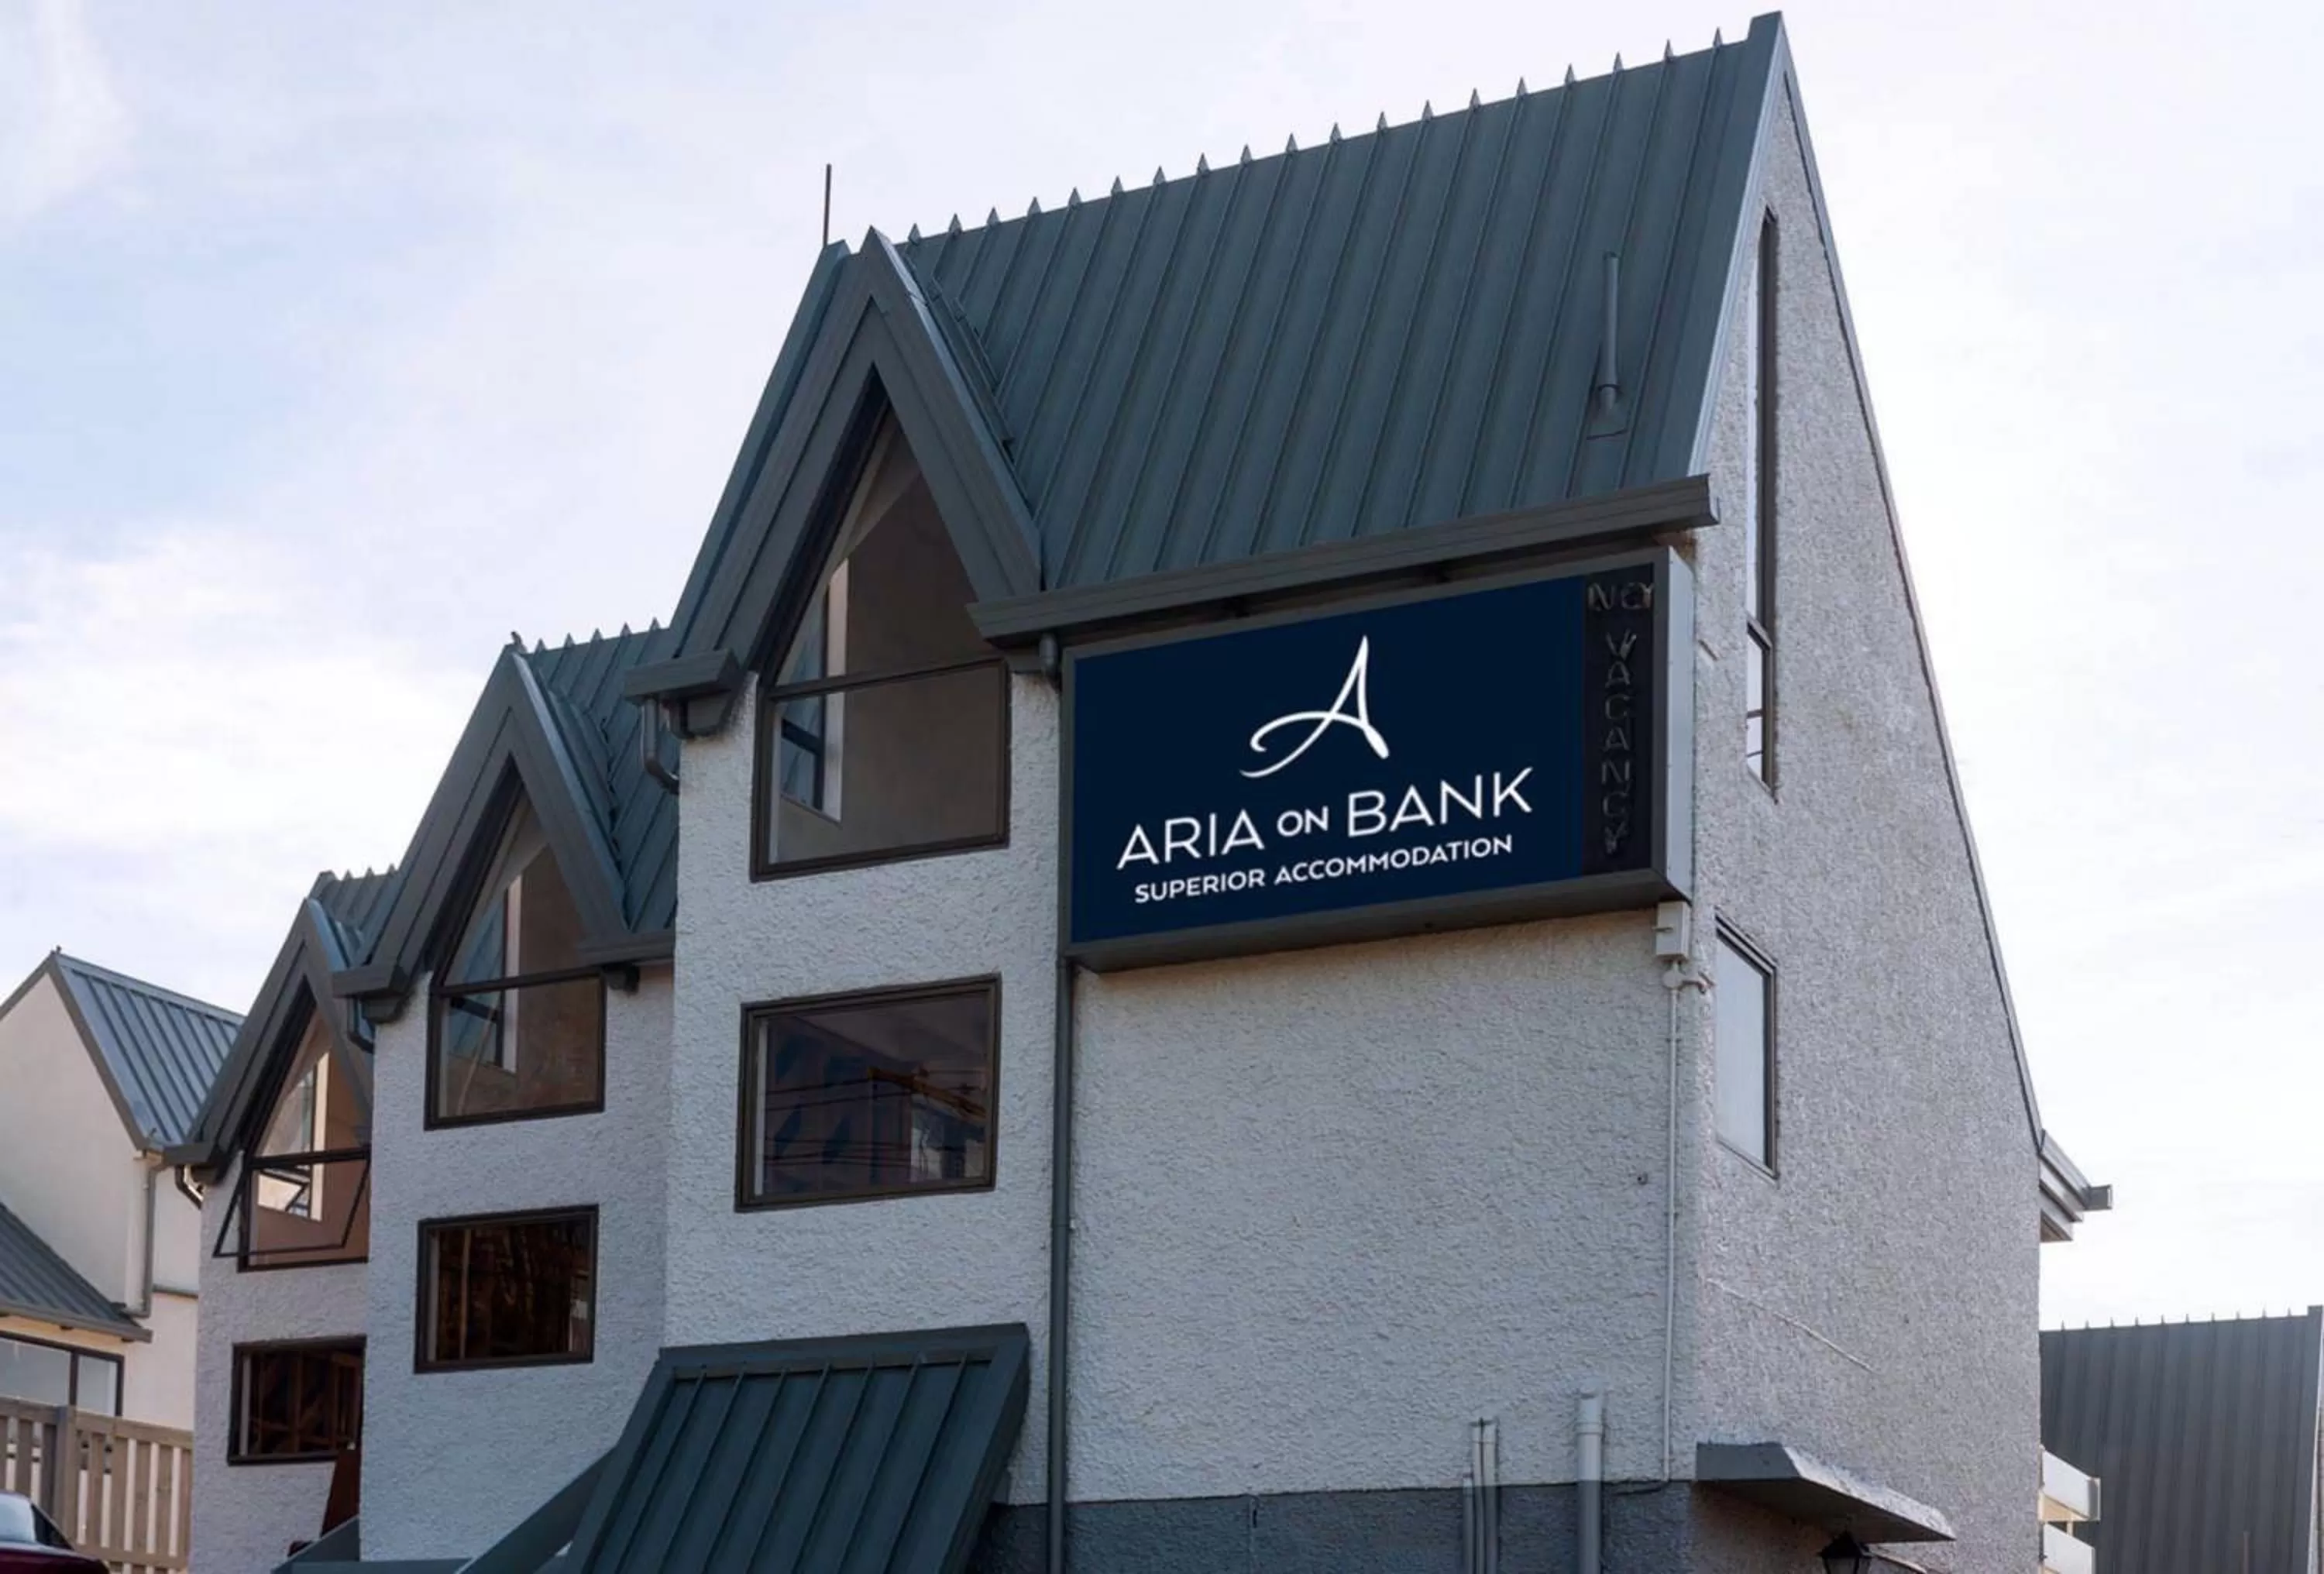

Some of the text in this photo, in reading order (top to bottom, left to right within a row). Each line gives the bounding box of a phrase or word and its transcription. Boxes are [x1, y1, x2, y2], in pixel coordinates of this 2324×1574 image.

[1601, 628, 1638, 854] VACANCY
[1116, 767, 1532, 869] ARIA ON BANK
[1135, 834, 1512, 903] SUPERIOR ACCOMMODATION
